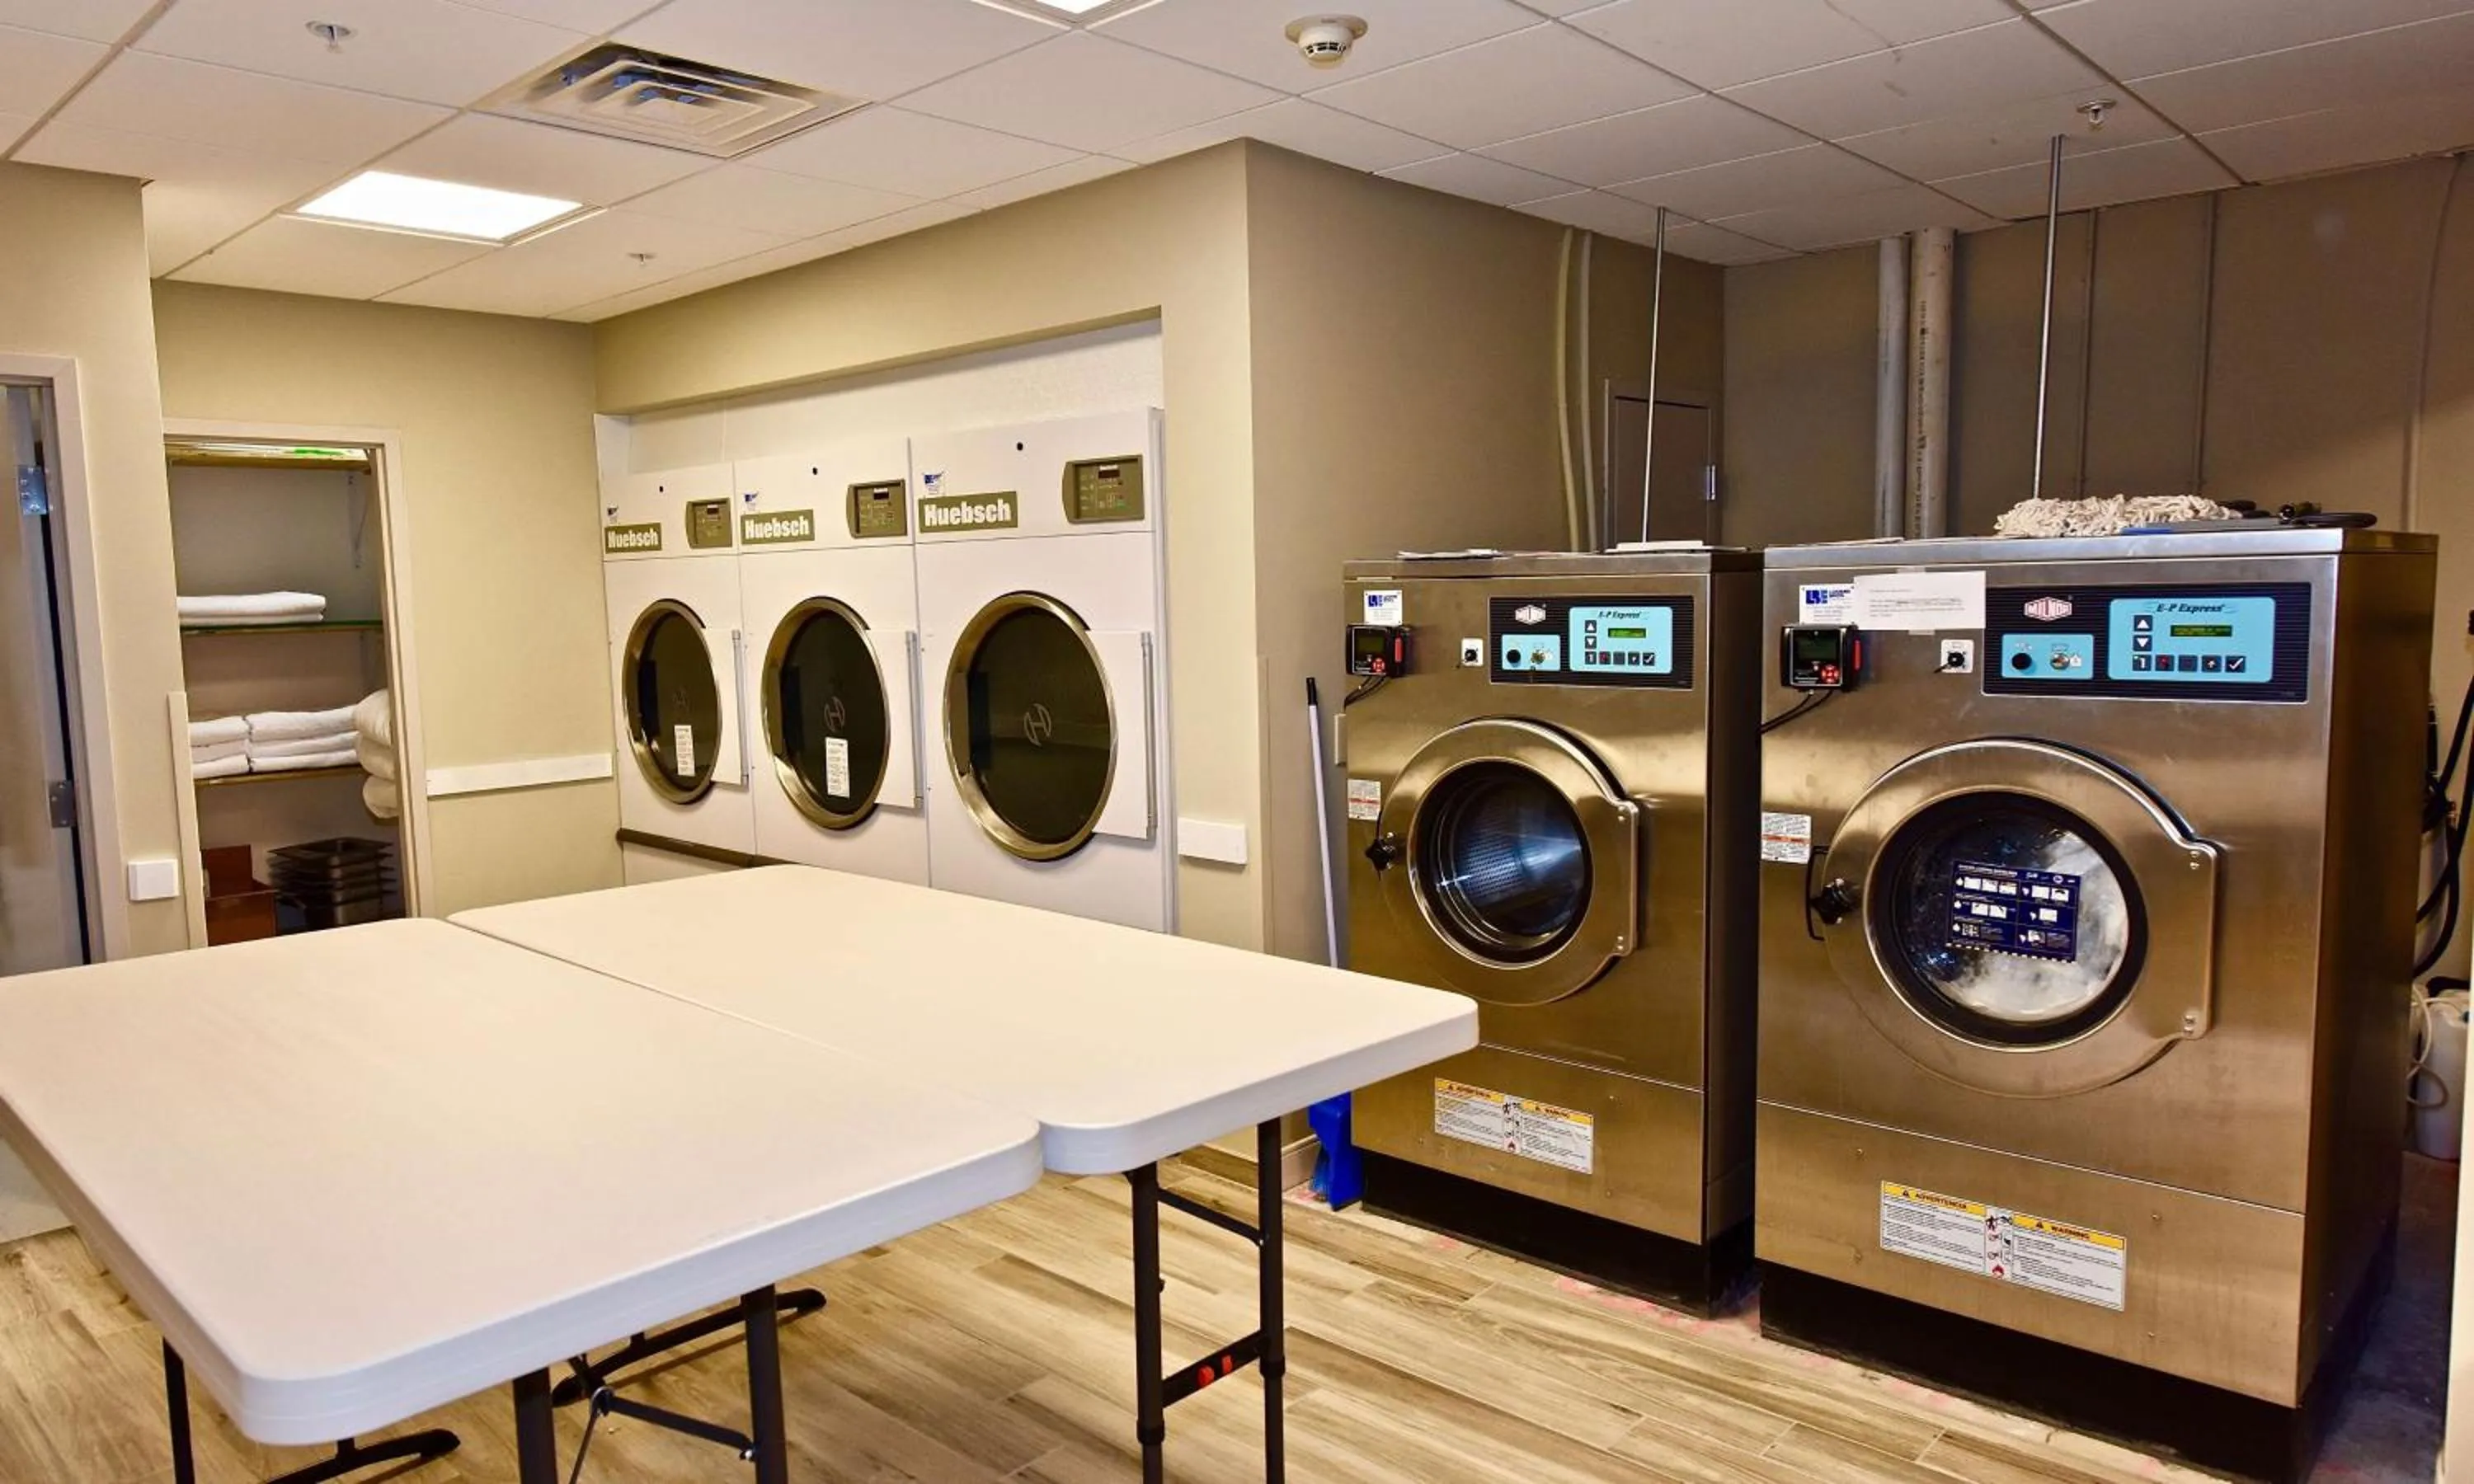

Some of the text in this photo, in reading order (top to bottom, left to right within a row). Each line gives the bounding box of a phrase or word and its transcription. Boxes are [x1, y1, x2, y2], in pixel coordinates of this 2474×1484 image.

[924, 498, 1011, 527] Huebsch
[745, 514, 810, 539] Huebsch
[608, 528, 659, 548] Huebsch
[2157, 603, 2222, 614] E-P Express
[2051, 1225, 2090, 1239] WARNING
